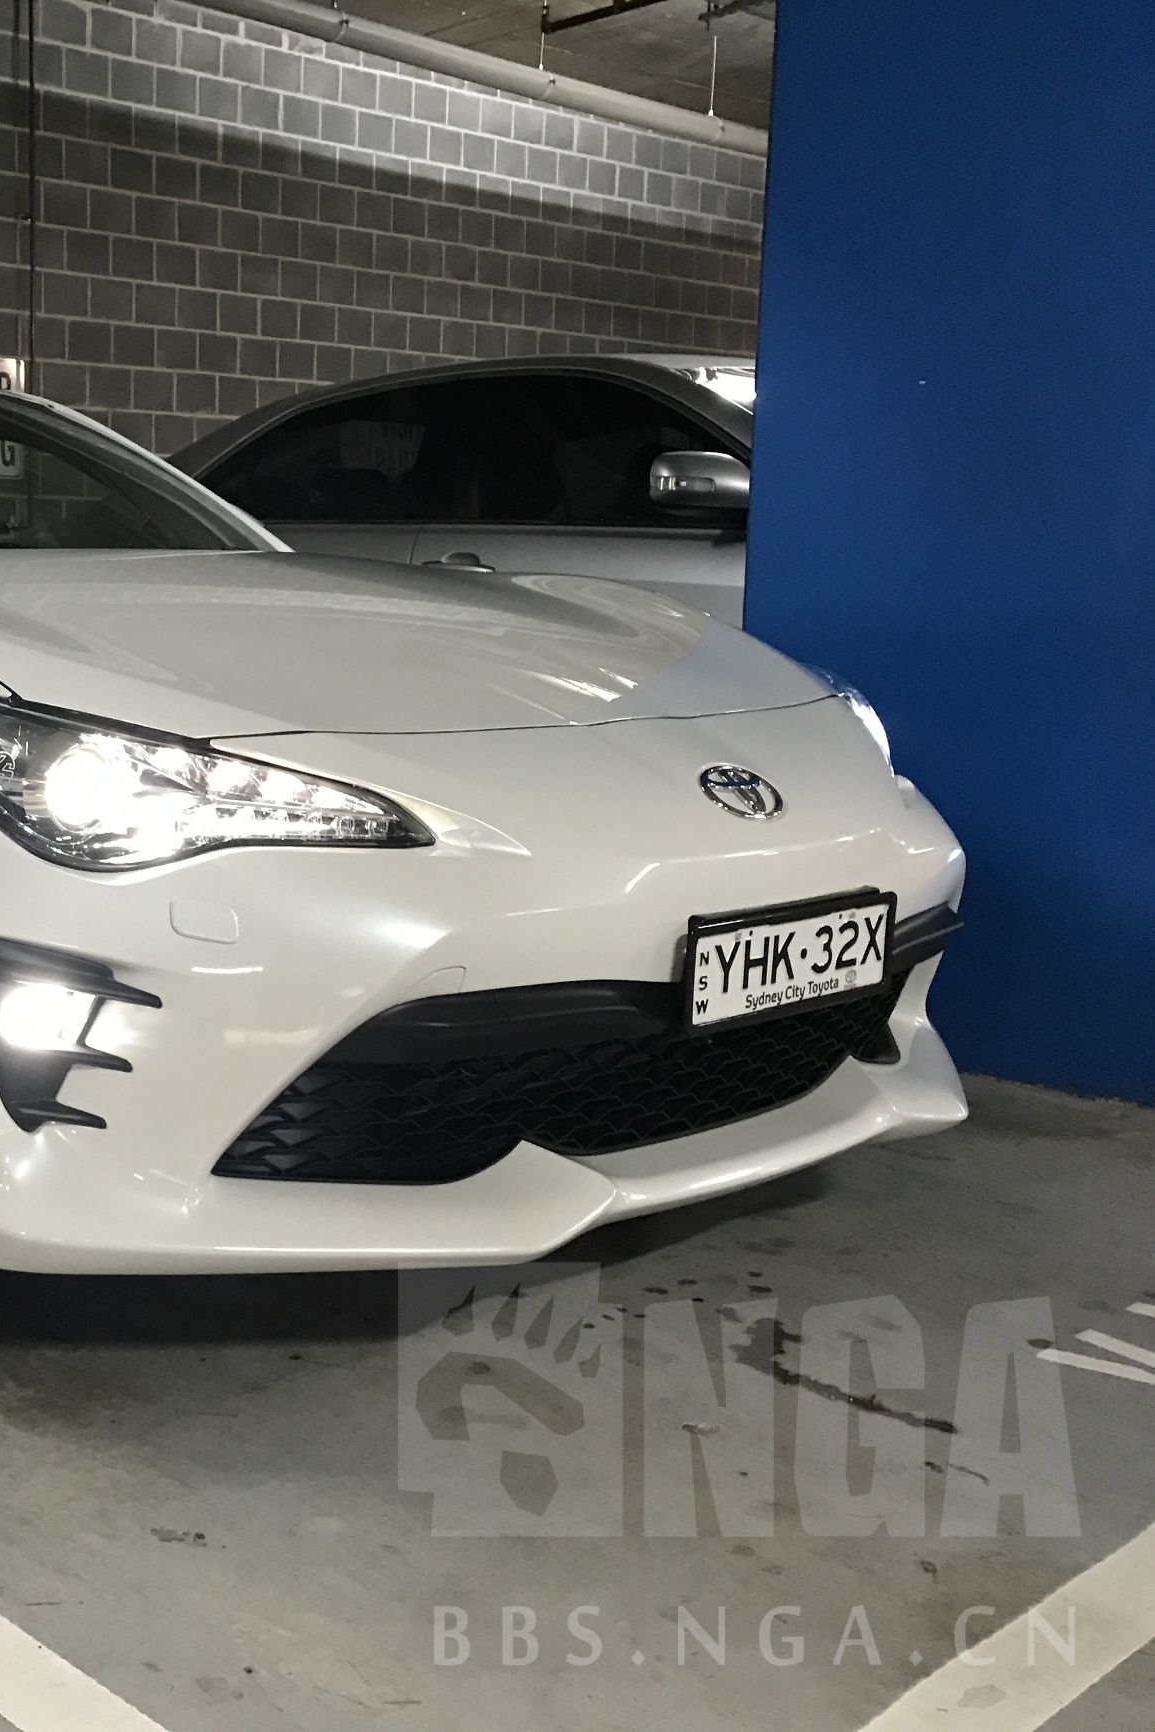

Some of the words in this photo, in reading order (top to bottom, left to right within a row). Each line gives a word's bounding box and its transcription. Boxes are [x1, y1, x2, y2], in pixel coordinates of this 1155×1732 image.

[745, 990, 784, 1010] Sydney
[785, 983, 806, 1001] City
[807, 977, 839, 997] Toyota
